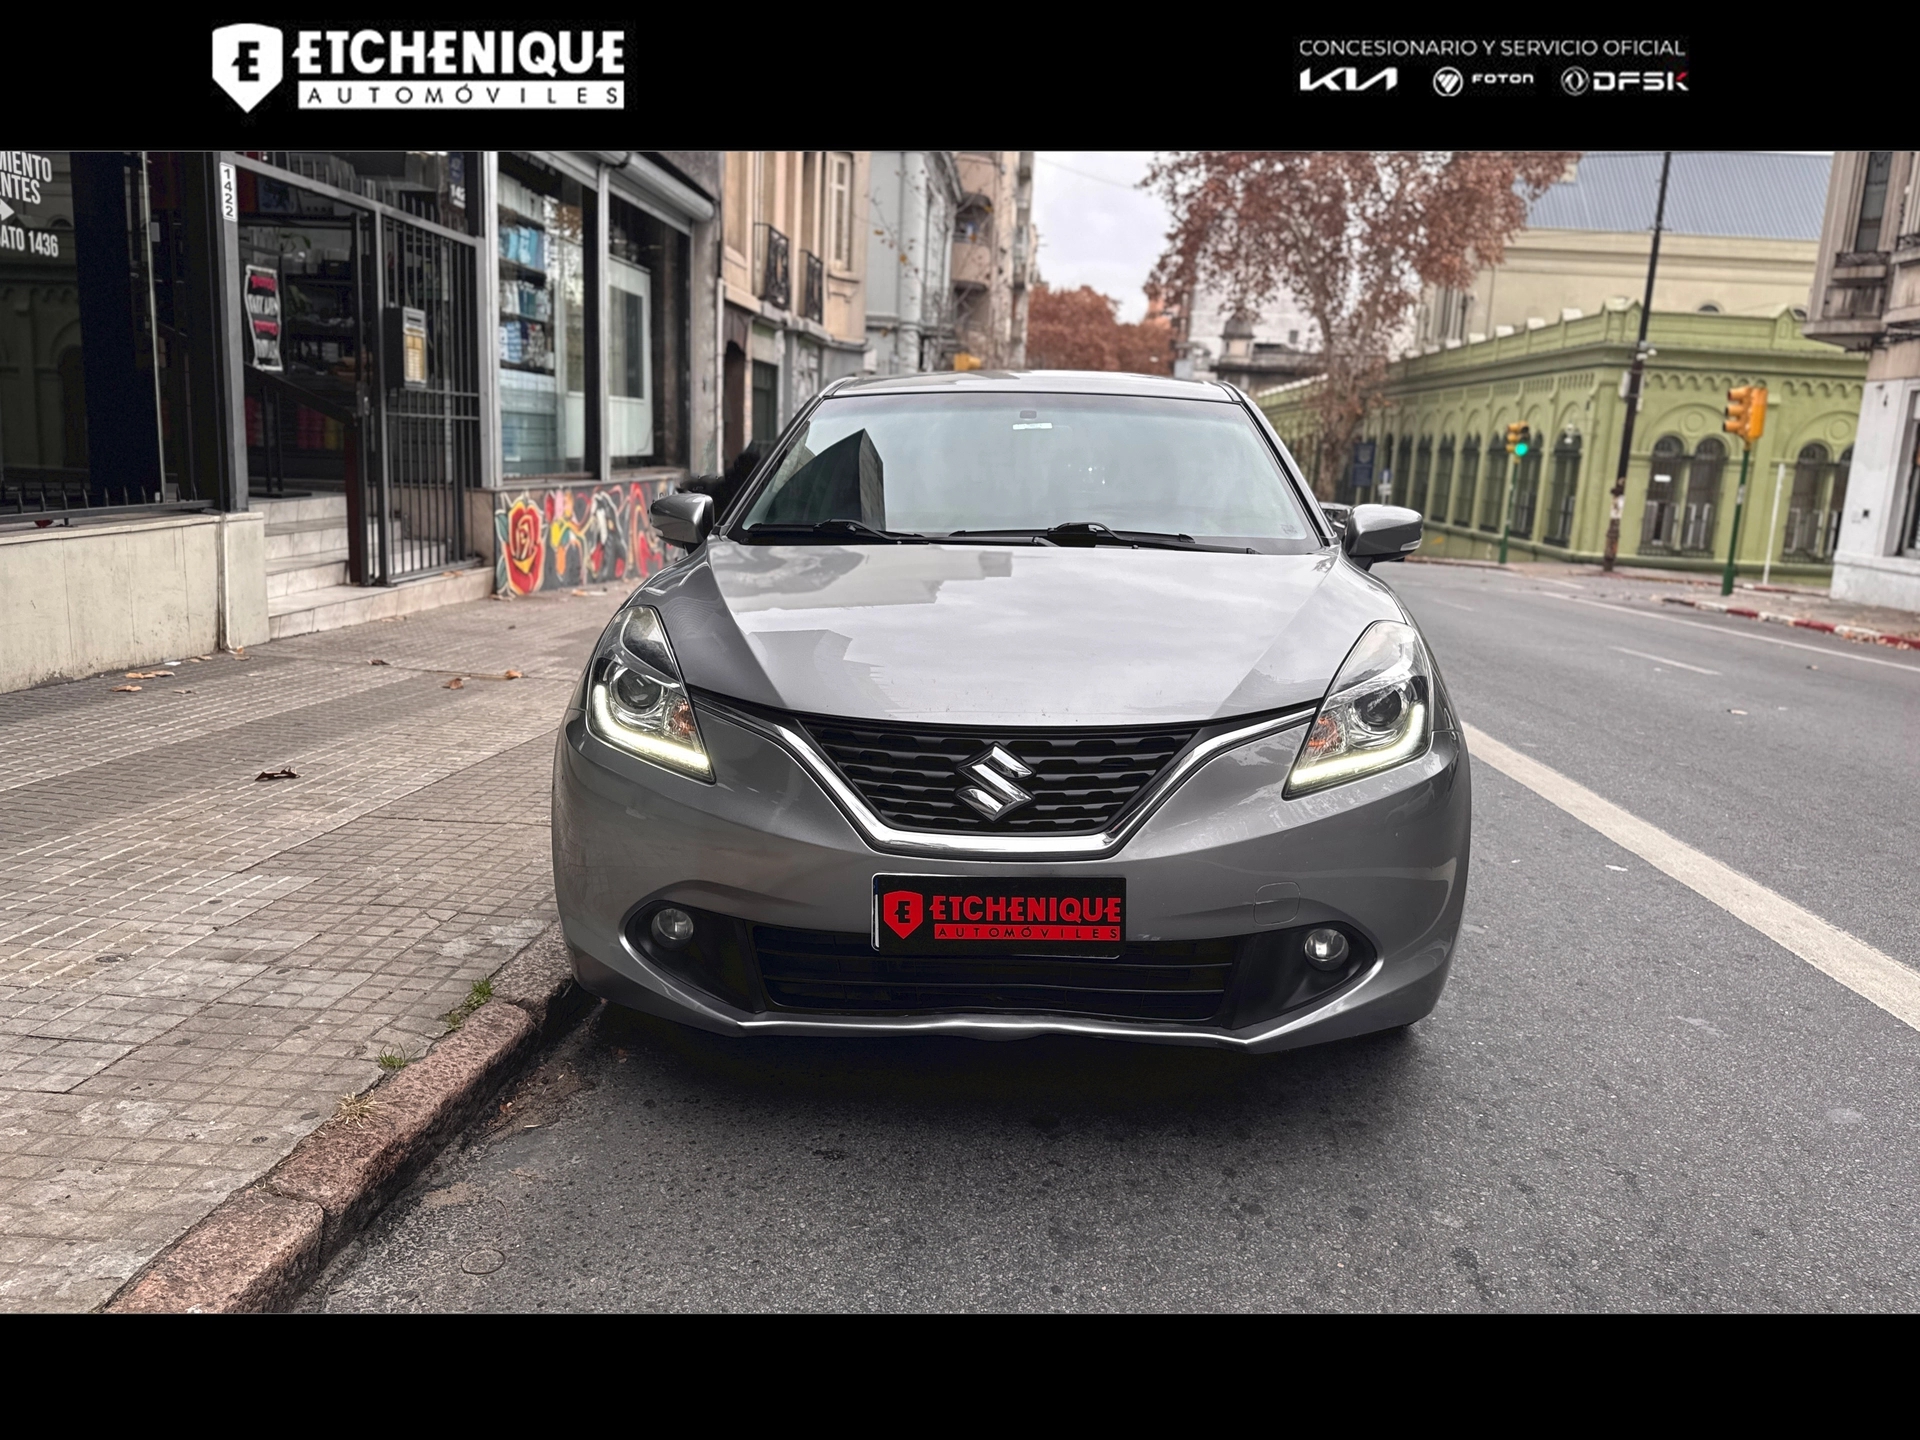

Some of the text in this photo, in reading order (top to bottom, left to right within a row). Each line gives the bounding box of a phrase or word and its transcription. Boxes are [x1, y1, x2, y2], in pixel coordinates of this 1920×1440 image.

[0, 171, 41, 205] NTES
[224, 168, 234, 217] 1422
[28, 230, 59, 257] 1436
